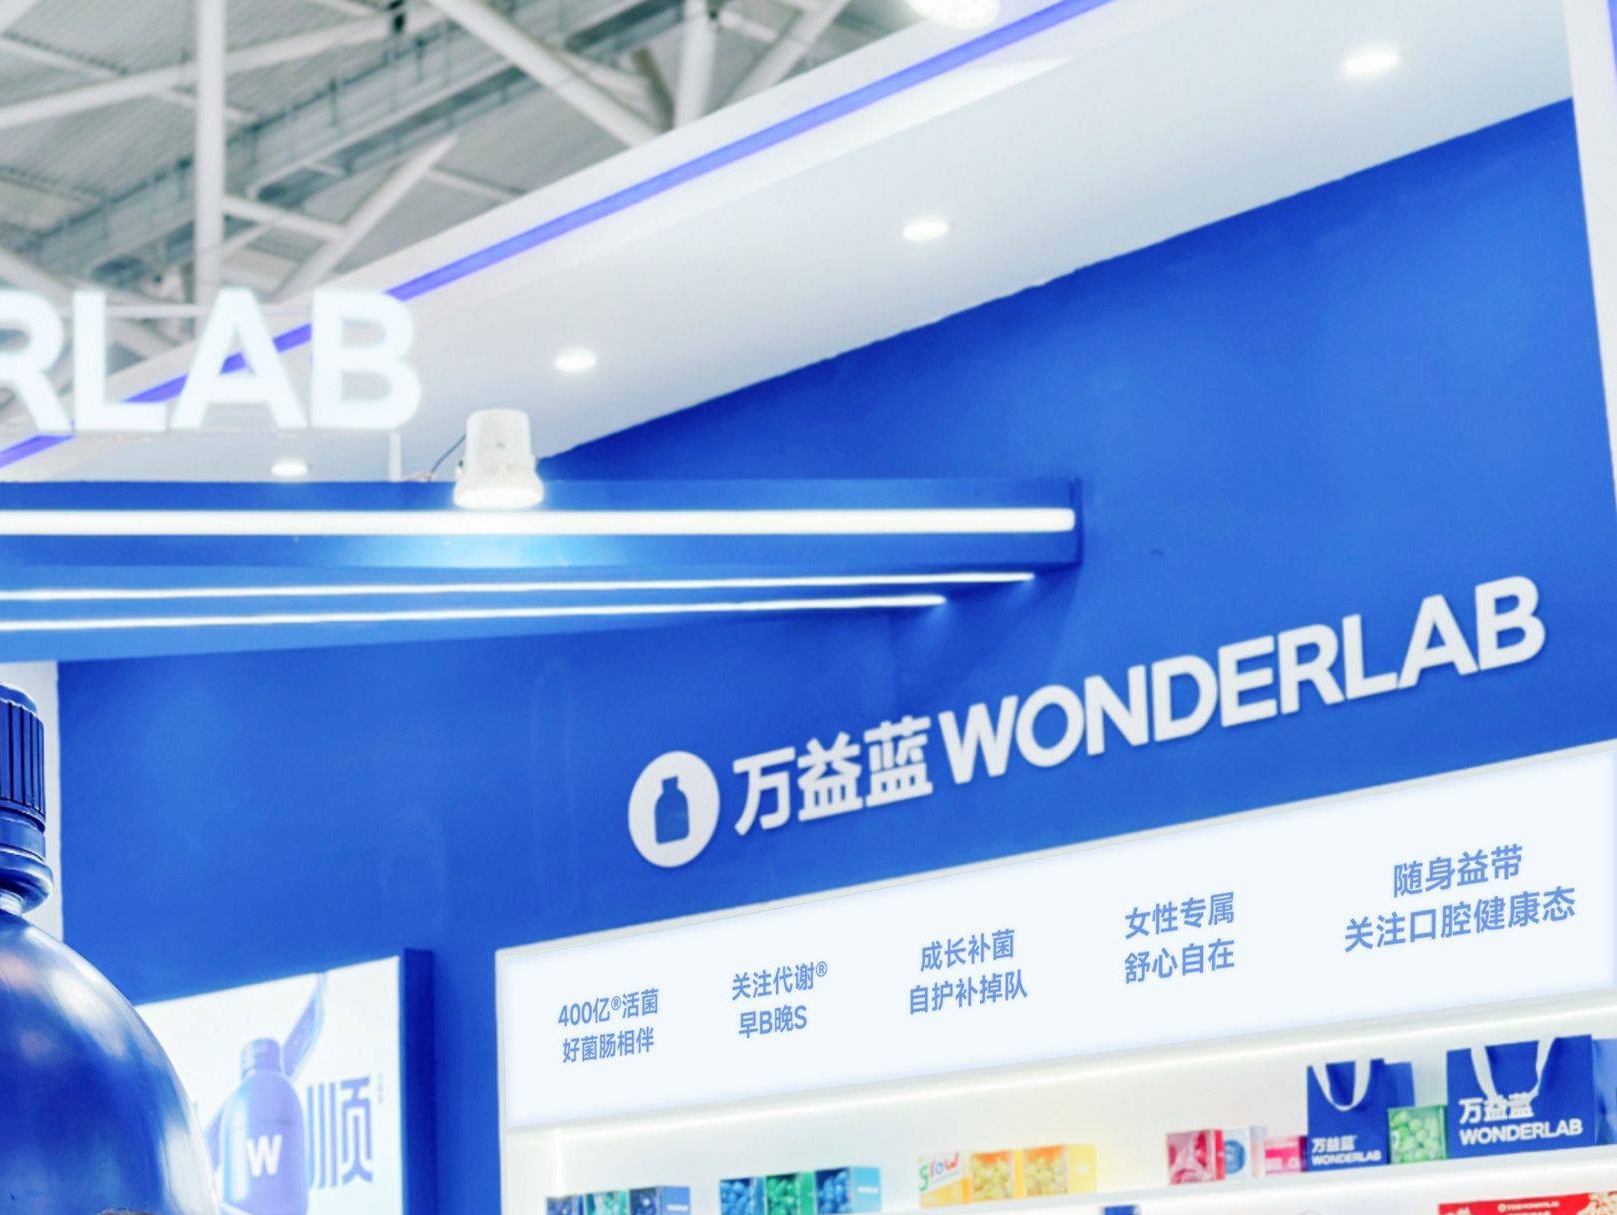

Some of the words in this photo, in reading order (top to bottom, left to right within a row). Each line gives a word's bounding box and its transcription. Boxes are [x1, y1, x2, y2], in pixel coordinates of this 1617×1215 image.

[731, 715, 934, 837] 万益蓝
[938, 574, 1547, 785] WONDERLAB
[1392, 843, 1524, 898] 随身益带
[1124, 891, 1236, 940] 女性专属
[1344, 885, 1576, 953] 关注口腔健康态
[920, 929, 1016, 972] 成长补菌
[1124, 938, 1236, 985] 舒心自在
[909, 968, 1029, 1016] 自护补掉队
[738, 1003, 808, 1039] 早B晚S
[562, 1026, 655, 1064] 好菌肠相伴
[1458, 1090, 1535, 1124] 万益蓝
[1459, 1117, 1584, 1146] WONDERLAB
[246, 1133, 283, 1178] W
[1311, 1148, 1382, 1168] WONDERLAB
